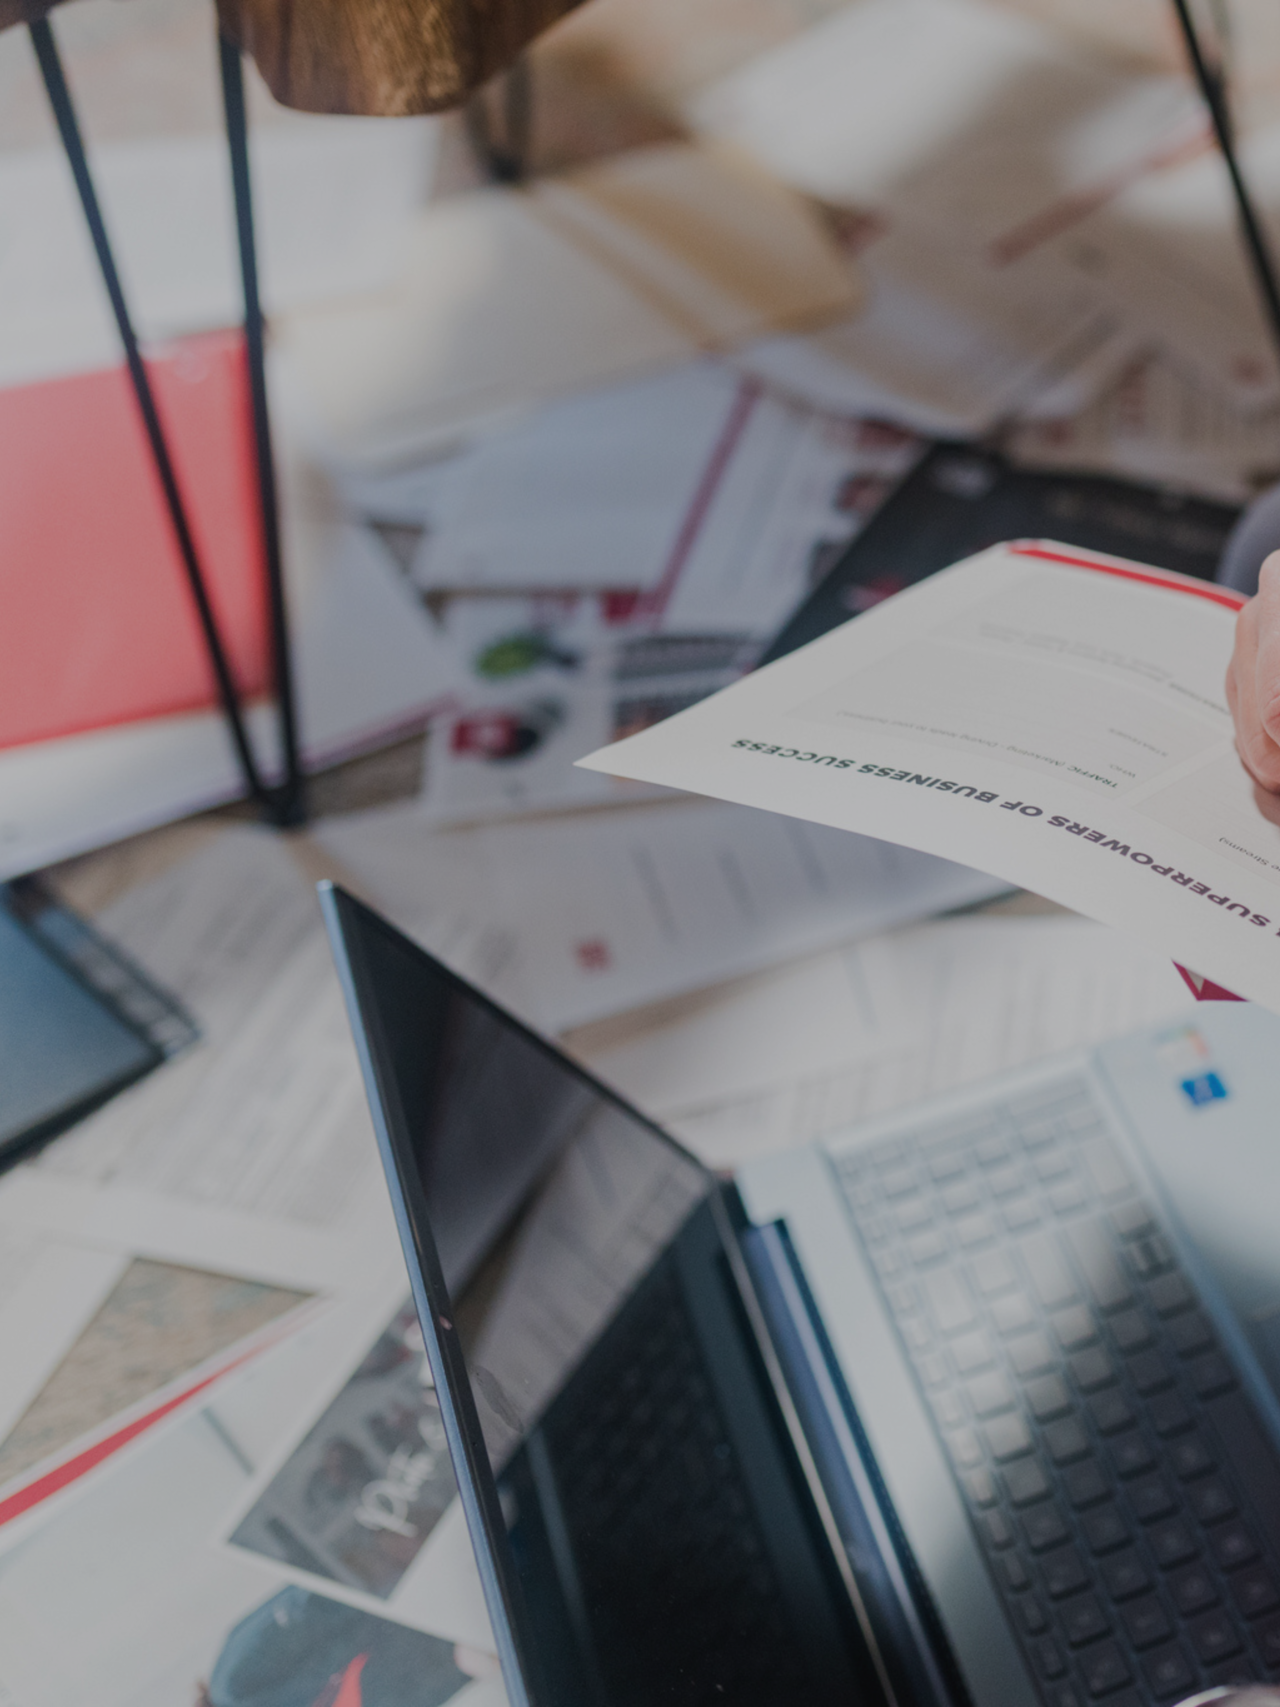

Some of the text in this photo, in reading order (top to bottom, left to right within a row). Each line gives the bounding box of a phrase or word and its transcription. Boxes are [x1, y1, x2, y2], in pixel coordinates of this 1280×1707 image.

[731, 738, 855, 769] SUCCESS
[857, 763, 999, 803] BUSINESS
[1066, 764, 1119, 788] TRAFFIC
[1000, 800, 1043, 818] OF
[1046, 814, 1271, 928] SUPERPOWERS
